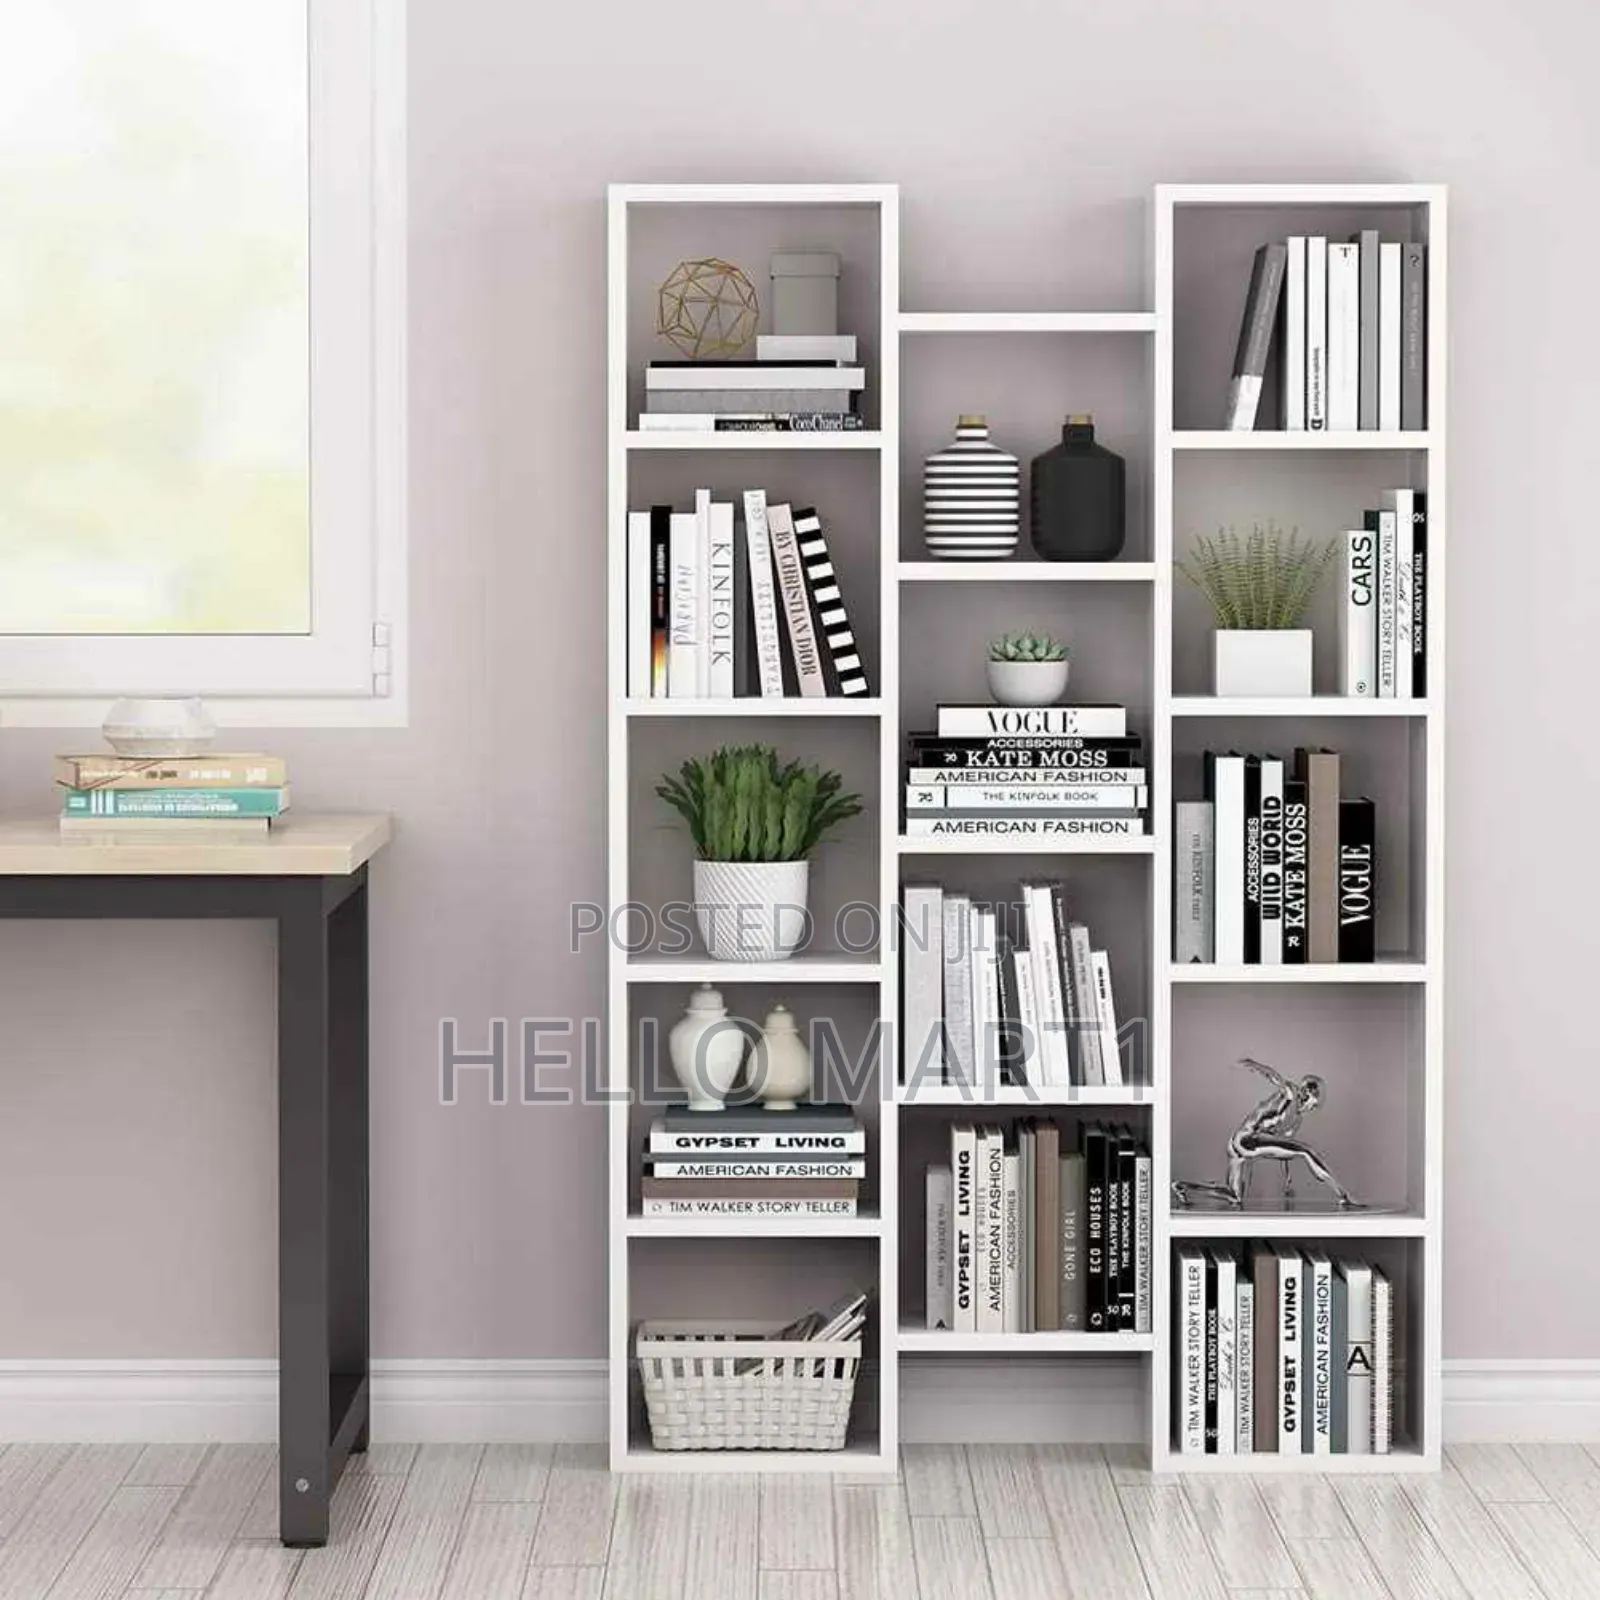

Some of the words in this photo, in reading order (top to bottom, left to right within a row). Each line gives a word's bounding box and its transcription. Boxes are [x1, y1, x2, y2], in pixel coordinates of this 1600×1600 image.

[775, 530, 791, 551] BY
[1352, 536, 1372, 606] CARS
[1382, 558, 1393, 607] WALKER
[712, 543, 731, 666] KINFOLK
[779, 554, 808, 635] CHRISTIAN
[1382, 609, 1393, 646] STORY
[796, 637, 818, 677] DIOR
[987, 710, 1078, 734] VOGUE
[987, 738, 1084, 749] ACCESSORIES
[934, 771, 1037, 783] AMERICAN
[1043, 771, 1128, 783] FASHION
[965, 750, 1032, 767] KATE
[1039, 750, 1108, 767] MOSS
[983, 792, 1003, 801] THE
[1009, 792, 1060, 801] KINFOLK
[1064, 792, 1099, 801] BOOK
[932, 821, 1037, 834] AMERICAN
[1043, 821, 1129, 834] FASHION
[1262, 795, 1282, 866] WORLD
[1284, 802, 1306, 864] MOSS
[1248, 817, 1259, 903] ACCESSORIES
[1262, 872, 1281, 920] WILD
[1284, 869, 1306, 929] KATE
[1341, 844, 1371, 926] VOGUE
[675, 1137, 760, 1148] GYPSET
[775, 1137, 847, 1148] LIVING
[677, 1165, 770, 1176] AMERICAN
[775, 1165, 853, 1176] FASHION
[958, 1150, 970, 1216] LIVING
[989, 1148, 1001, 1220] FASHION
[669, 1202, 693, 1213] TIM
[697, 1202, 753, 1213] WALKER
[757, 1202, 800, 1213] STORY
[805, 1202, 850, 1213] TELLER
[1064, 1210, 1077, 1239] GIRL
[1090, 1187, 1102, 1238] HOUSES
[1006, 1190, 1016, 1270] ACCESSORIES
[958, 1230, 970, 1310] GYPSET
[989, 1225, 1001, 1311] AMERICAN
[1064, 1247, 1077, 1280] GONE
[1090, 1248, 1102, 1273] ECO
[1139, 1245, 1149, 1291] WALKER
[1189, 1265, 1200, 1306] TELLER
[1189, 1310, 1200, 1351] STORY
[1240, 1295, 1250, 1330] TELLER
[1284, 1277, 1296, 1341] LIVING
[1317, 1275, 1328, 1345] FASHION
[1240, 1333, 1250, 1366] STORY
[1346, 1345, 1372, 1370] A
[1189, 1354, 1200, 1405] WALKER
[1240, 1370, 1250, 1413] WALKER
[1284, 1355, 1296, 1432] GYPSET
[1317, 1350, 1328, 1434] AMERICAN
[1189, 1411, 1200, 1431] TIM
[1240, 1416, 1250, 1435] TIM
